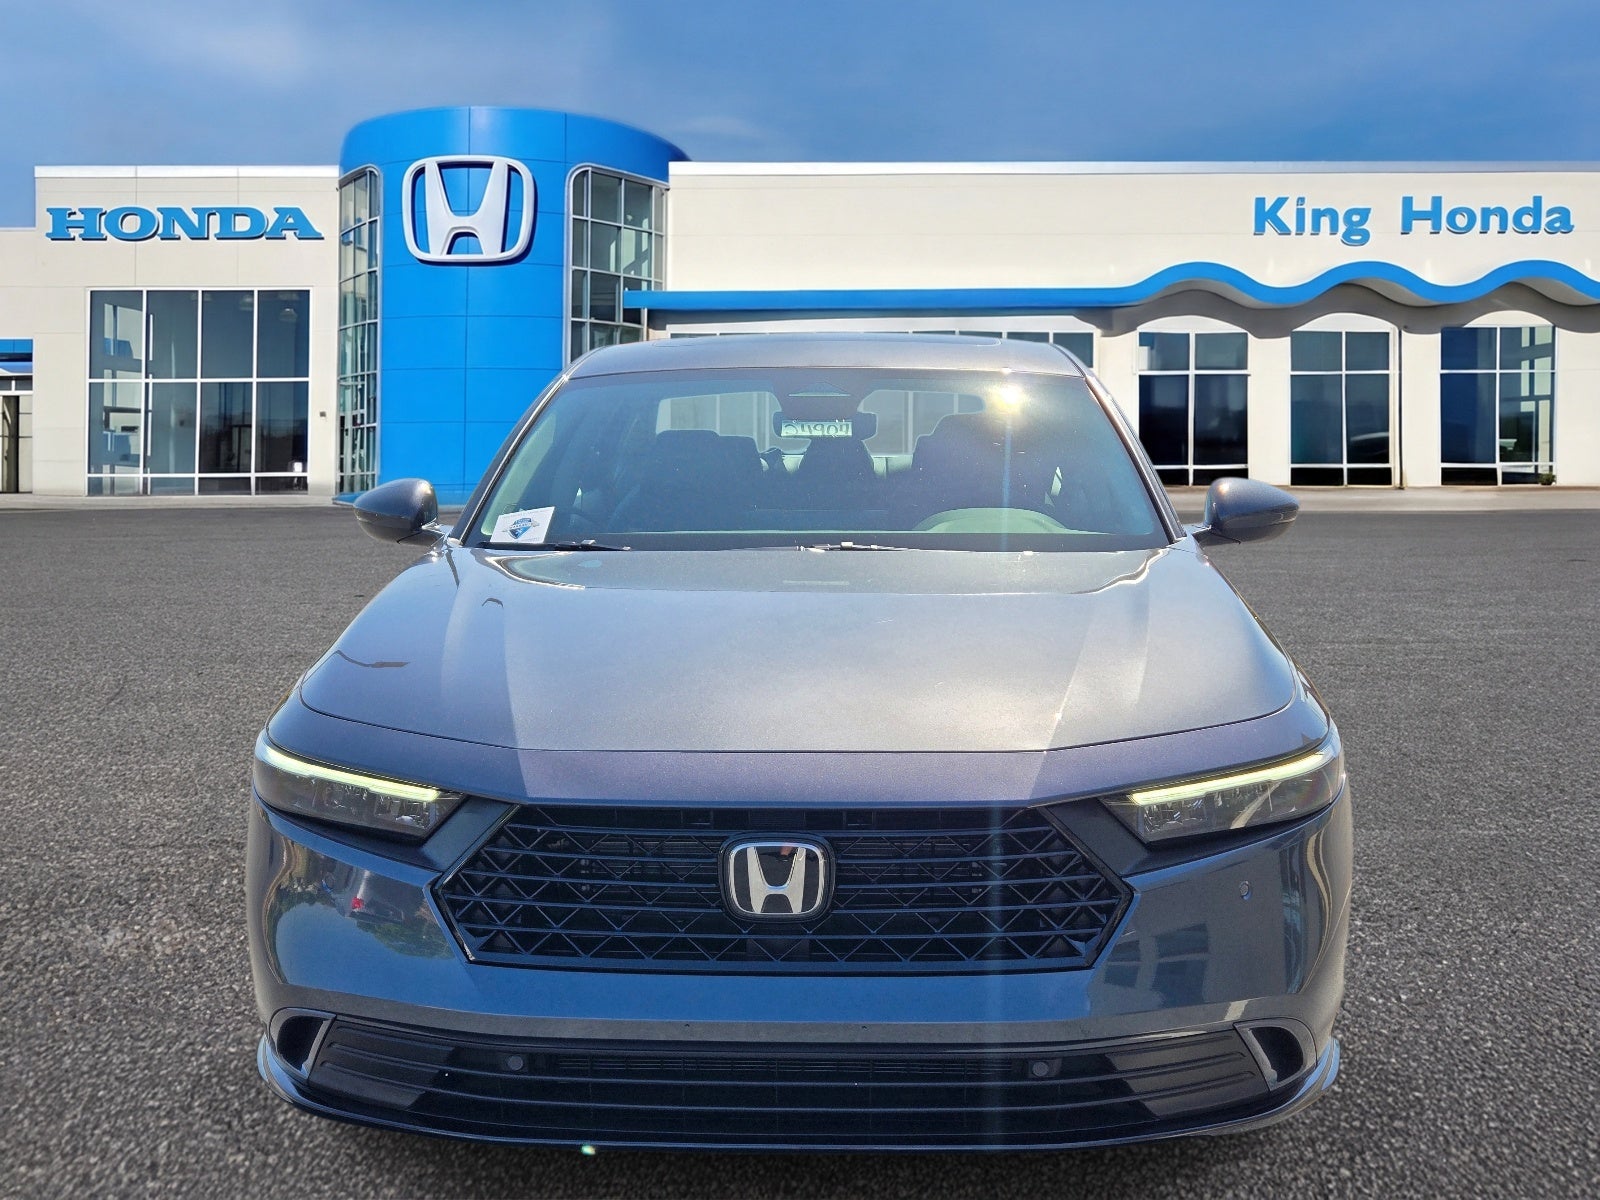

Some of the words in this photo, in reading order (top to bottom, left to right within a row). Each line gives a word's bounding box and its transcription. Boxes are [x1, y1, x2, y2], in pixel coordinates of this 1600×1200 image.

[46, 207, 323, 240] HONDA
[1254, 196, 1371, 245] King
[1401, 195, 1574, 234] Honda
